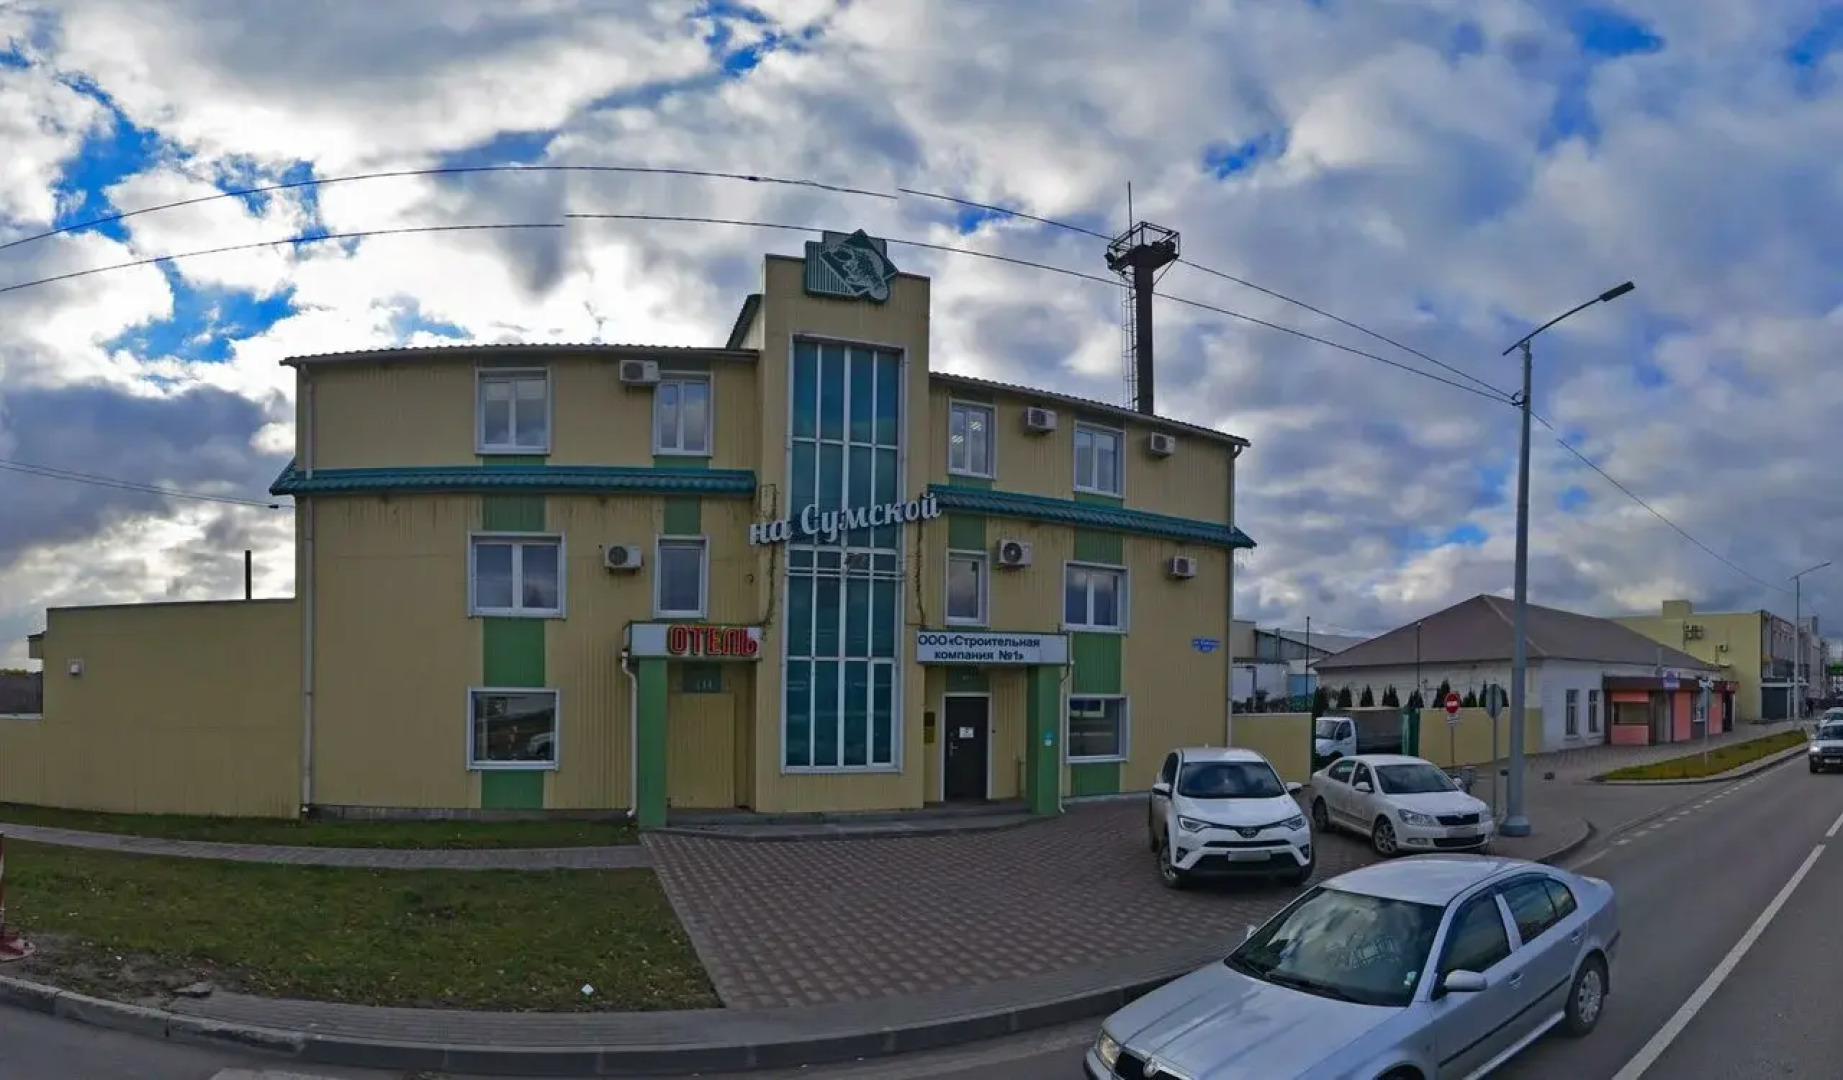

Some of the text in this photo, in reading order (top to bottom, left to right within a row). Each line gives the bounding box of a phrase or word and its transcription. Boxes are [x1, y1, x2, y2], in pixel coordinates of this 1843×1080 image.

[750, 492, 942, 545] на Сумской
[668, 623, 760, 657] ОТЕЛЬ
[934, 650, 1025, 660] компания №1»
